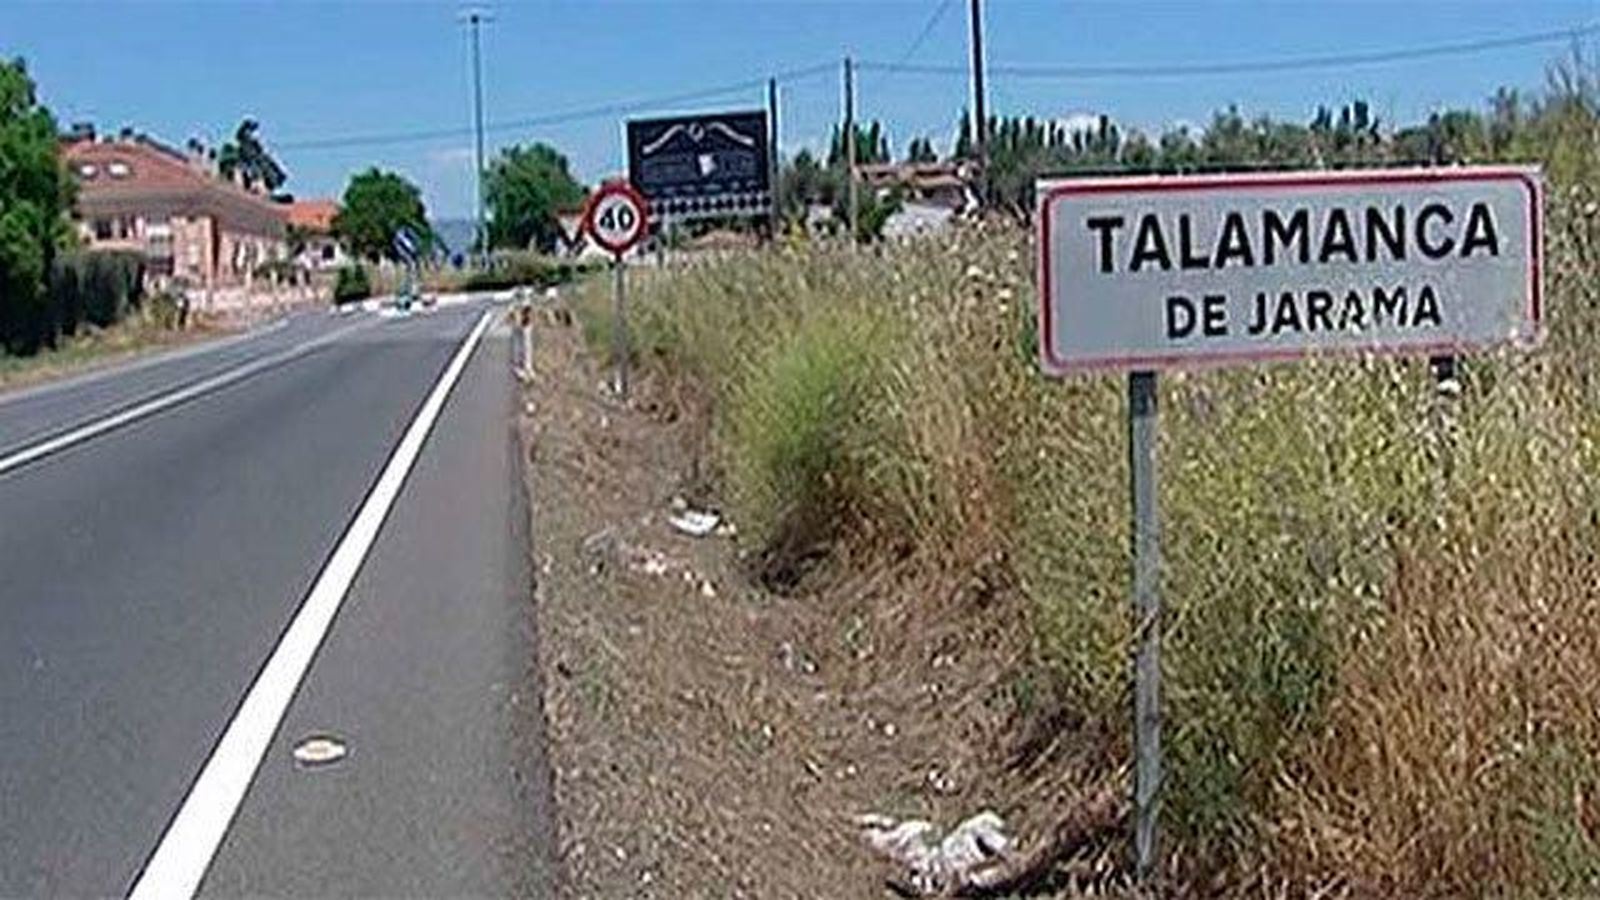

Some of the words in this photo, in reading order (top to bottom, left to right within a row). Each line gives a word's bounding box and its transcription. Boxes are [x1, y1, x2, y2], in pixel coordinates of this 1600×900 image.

[599, 204, 635, 231] 40
[1086, 202, 1499, 273] TALAMANCA
[1166, 295, 1229, 341] DE
[1247, 285, 1443, 336] JARAMA
